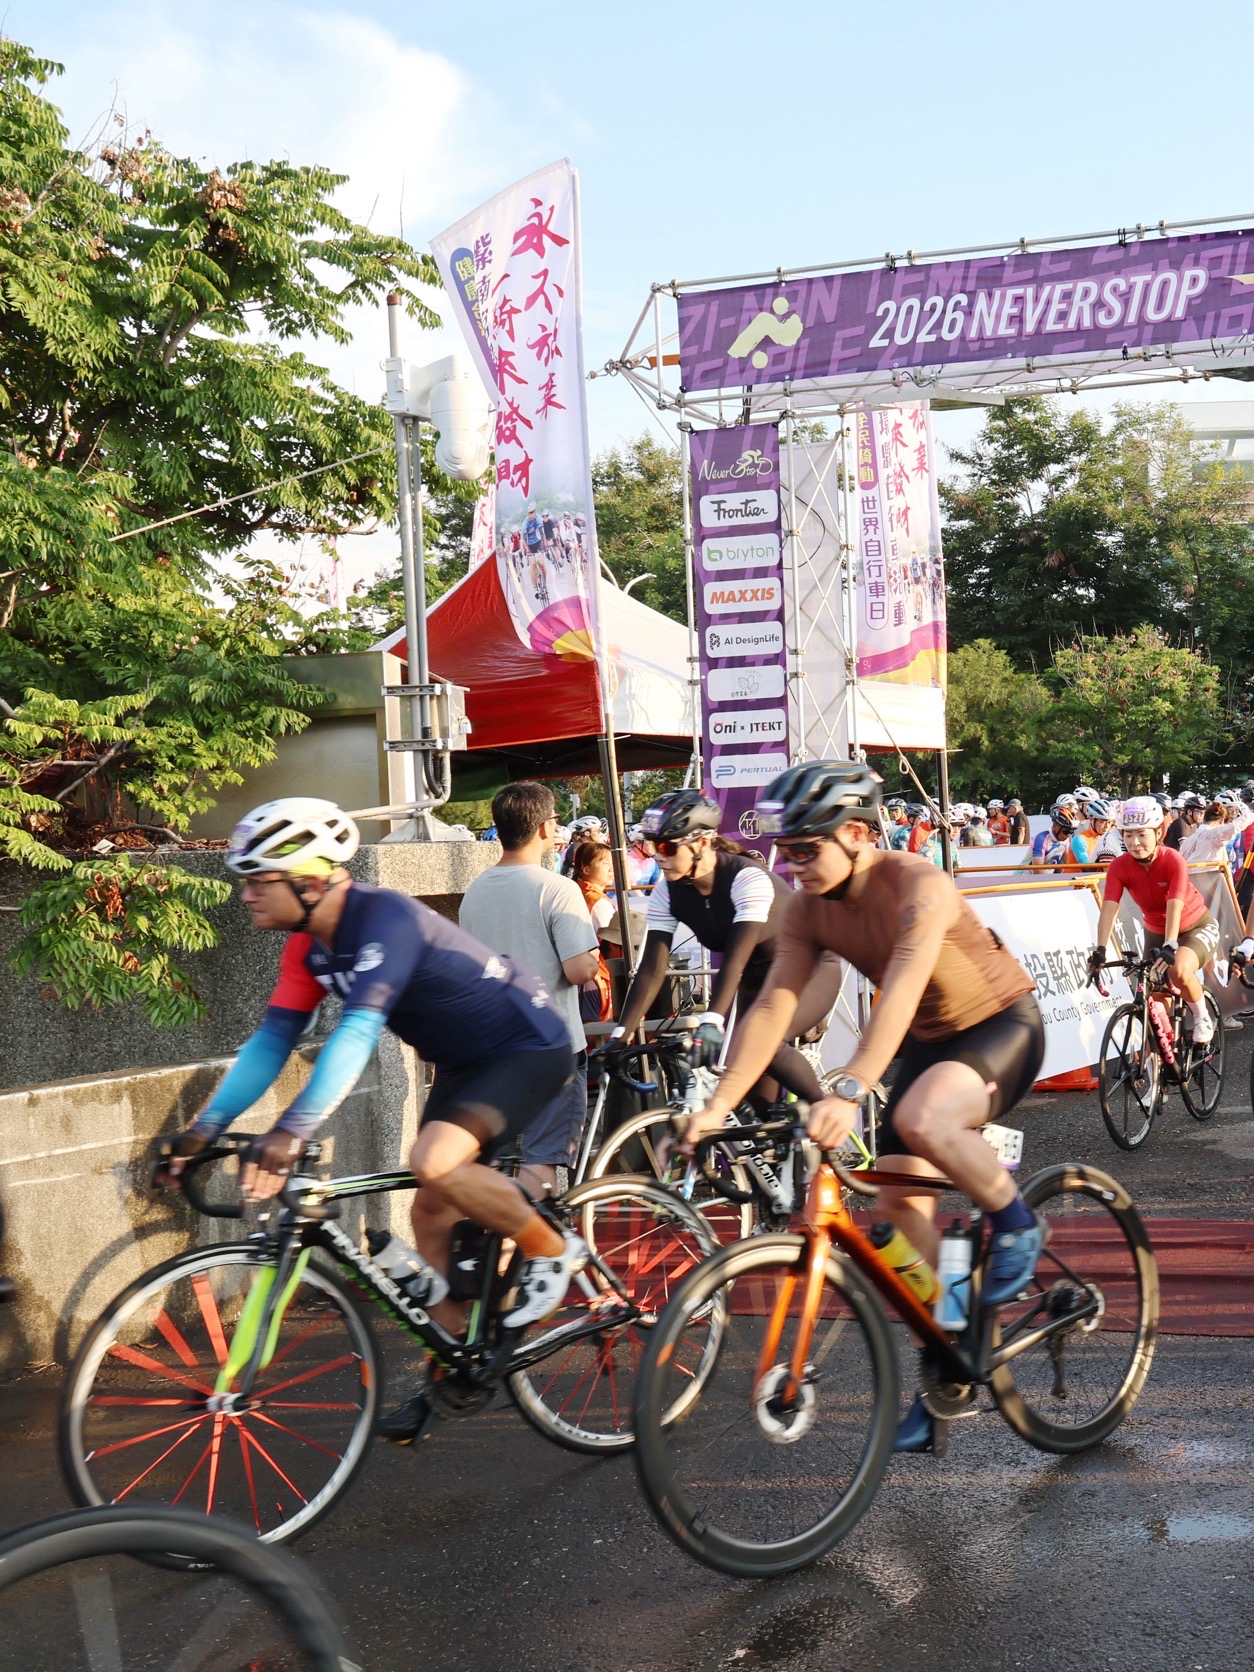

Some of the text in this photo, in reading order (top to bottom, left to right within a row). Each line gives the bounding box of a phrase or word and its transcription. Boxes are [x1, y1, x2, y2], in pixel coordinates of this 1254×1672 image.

[868, 267, 1209, 348] 2026 NEVERSTOP
[710, 498, 768, 521] Frontier
[727, 545, 775, 561] bryton
[861, 495, 885, 620] 世界自行車日
[710, 587, 775, 604] MAXXIS
[735, 634, 780, 646] DesignLife
[749, 720, 783, 734] JTEKT
[741, 766, 784, 774] PERTUAL
[1123, 813, 1145, 824] 2527
[1053, 1005, 1082, 1021] County
[1080, 995, 1123, 1016] Government
[320, 1220, 430, 1325] PINARELLO
